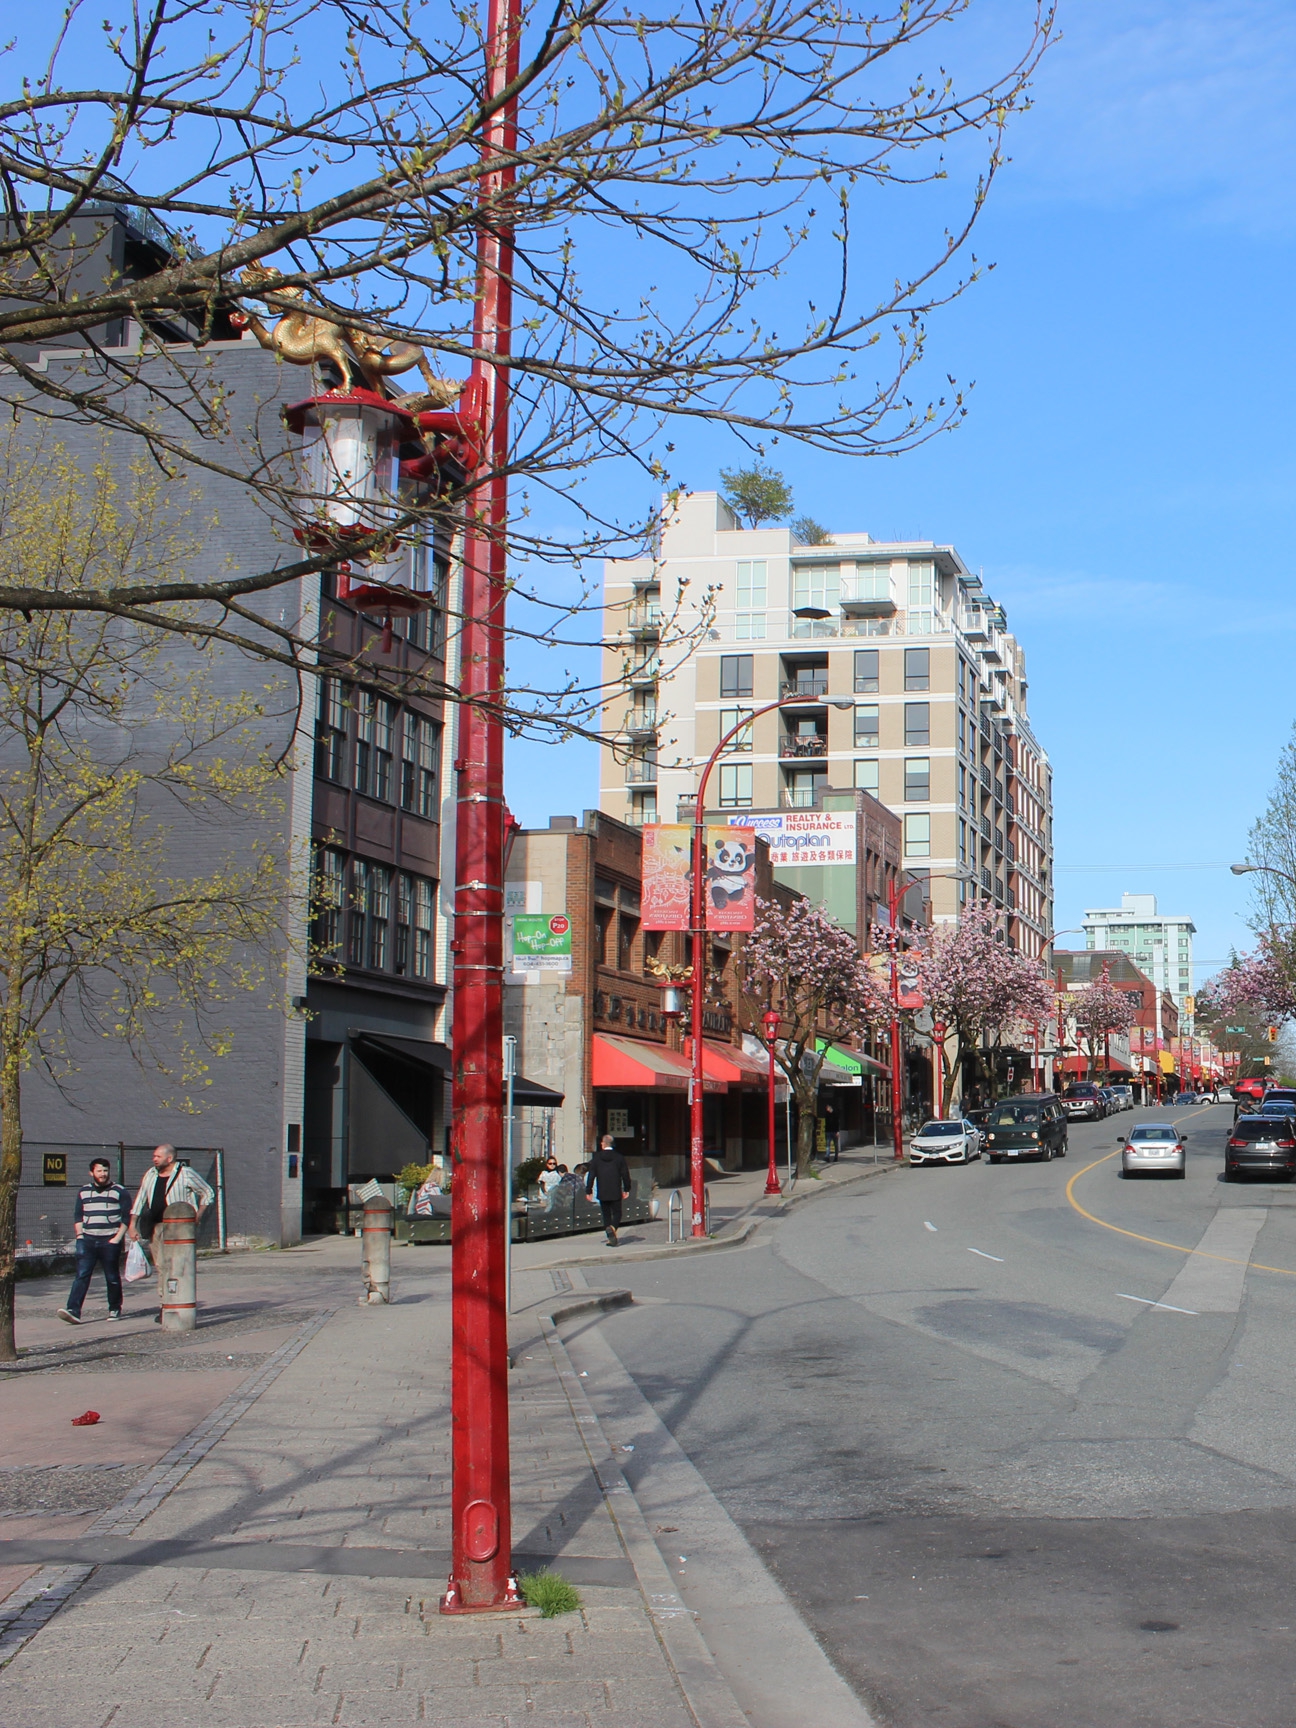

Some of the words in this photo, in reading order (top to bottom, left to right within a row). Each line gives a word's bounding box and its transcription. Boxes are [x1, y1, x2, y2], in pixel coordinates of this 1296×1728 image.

[786, 814, 821, 823] REALTY
[825, 813, 832, 821] &
[786, 822, 842, 831] INSURANCE
[516, 930, 547, 943] Hop-On
[47, 1158, 63, 1170] NO
